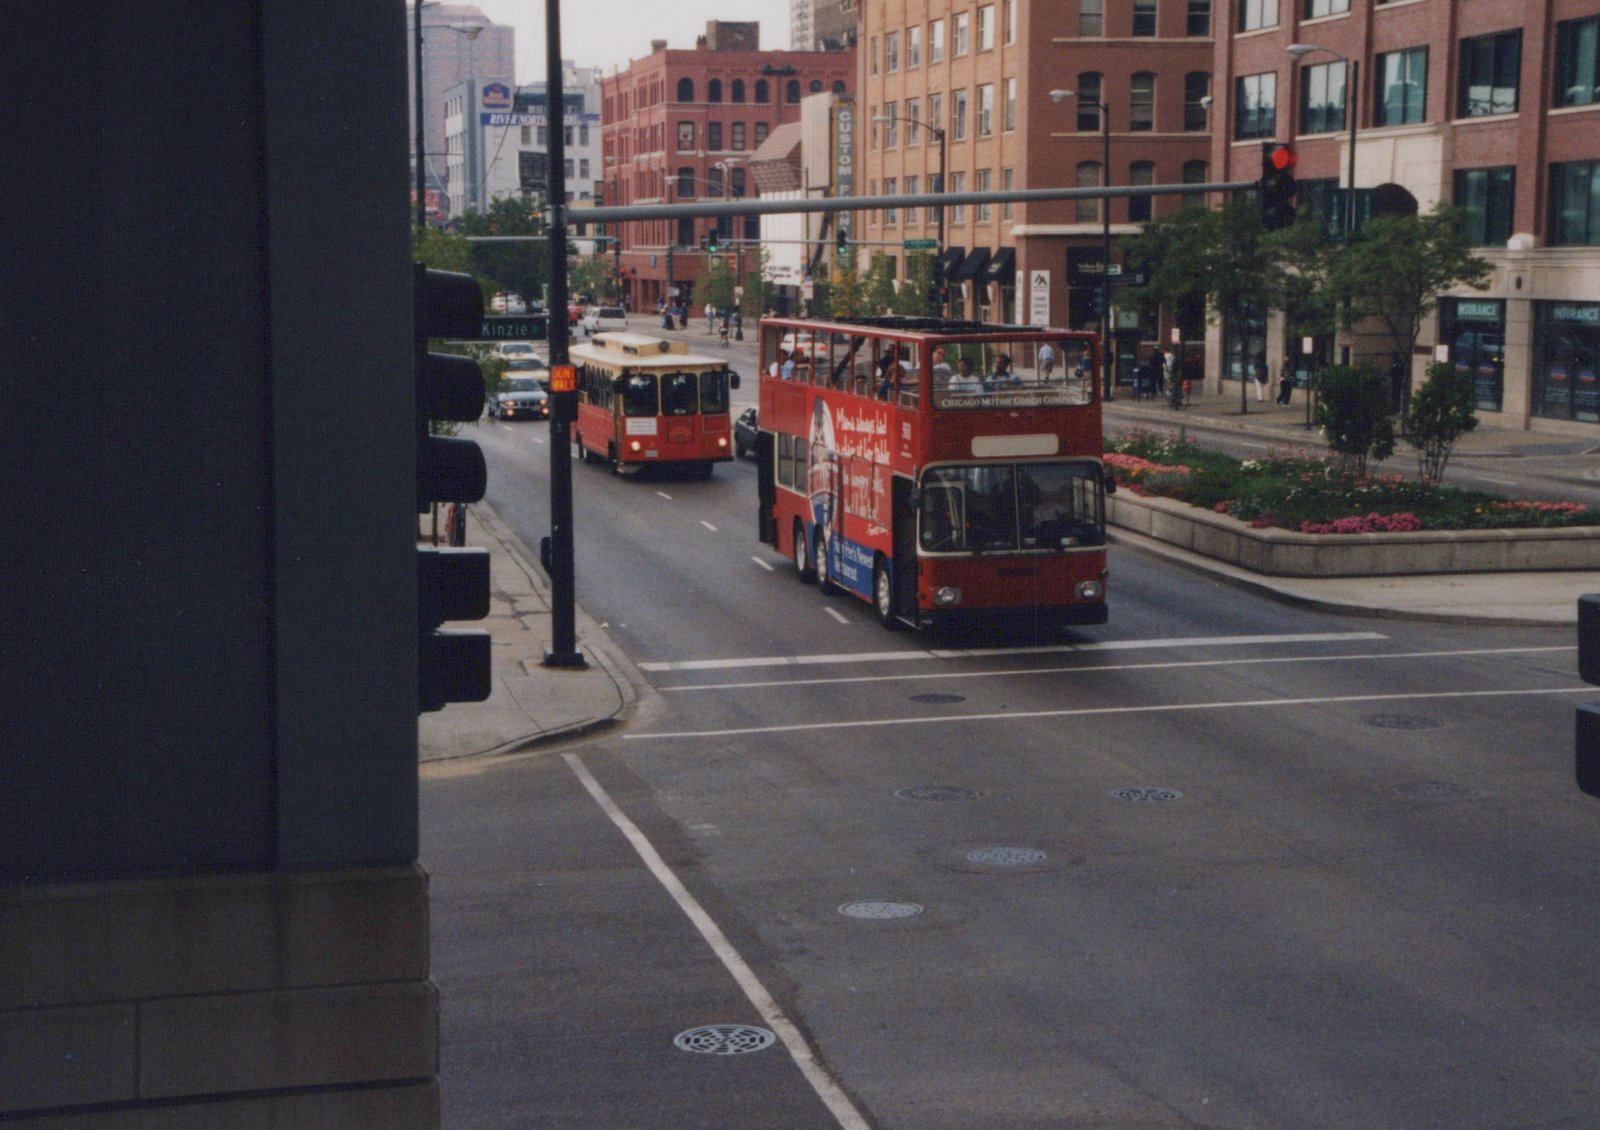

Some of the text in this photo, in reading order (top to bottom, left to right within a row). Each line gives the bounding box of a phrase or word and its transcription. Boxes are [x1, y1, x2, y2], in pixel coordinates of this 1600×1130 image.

[489, 114, 518, 126] RIVER
[838, 111, 852, 176] CUSTOM
[482, 321, 529, 337] Kinzie
[941, 398, 981, 408] CHICAGO
[981, 397, 1012, 407] MOTOR
[1013, 396, 1042, 406] COACH
